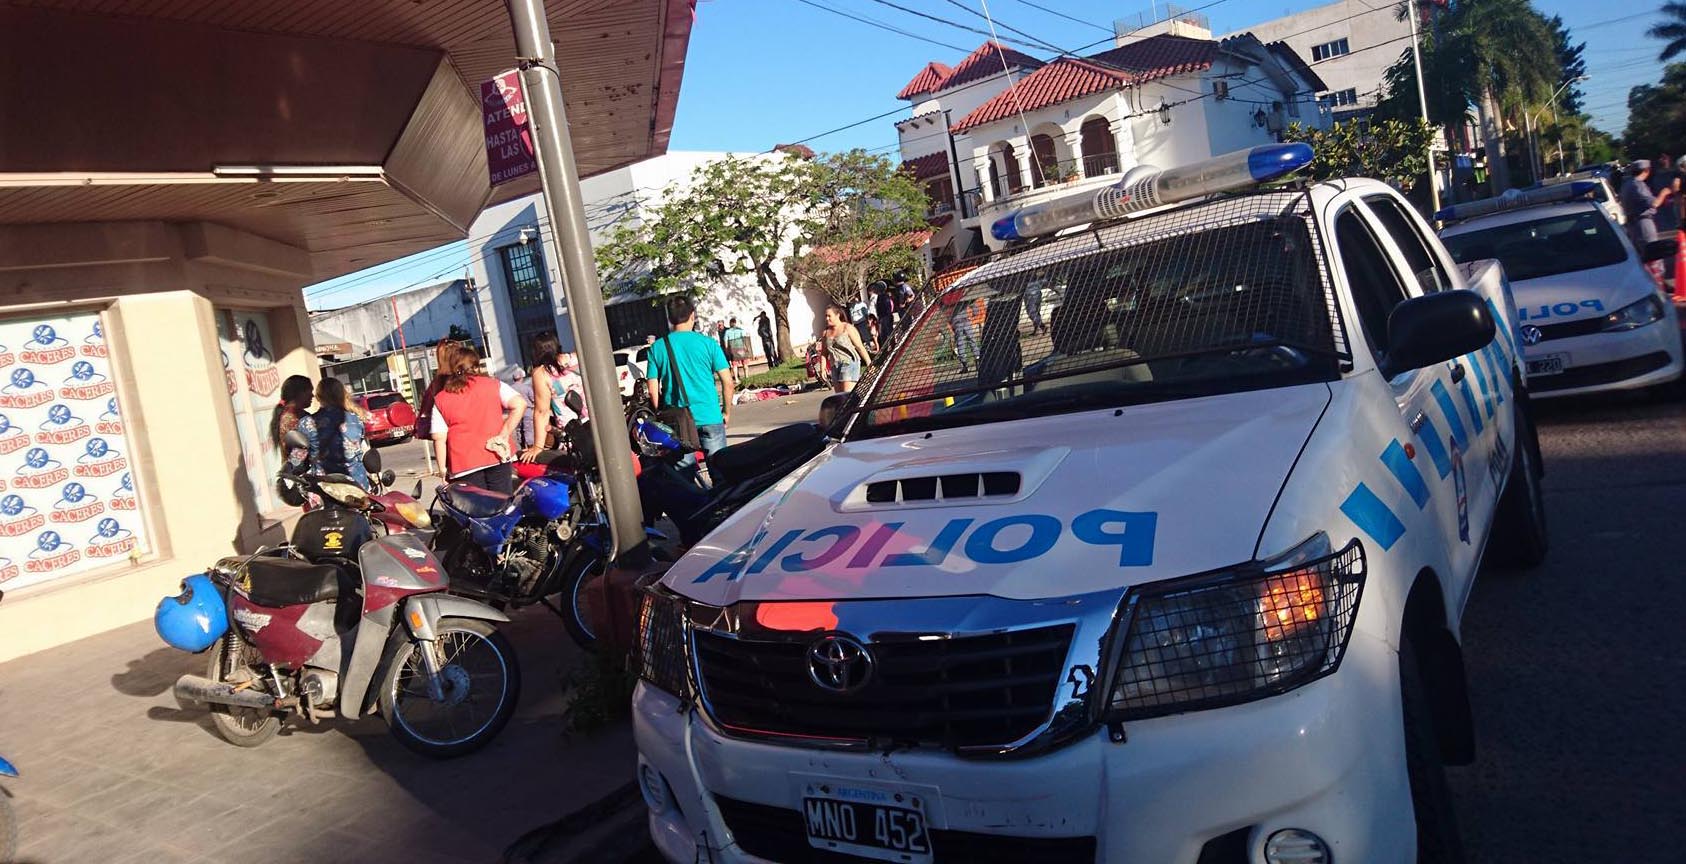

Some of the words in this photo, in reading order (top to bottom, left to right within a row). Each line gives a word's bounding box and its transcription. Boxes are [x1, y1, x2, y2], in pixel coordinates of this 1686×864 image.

[486, 128, 518, 149] HASTA
[501, 142, 519, 159] LAS
[492, 172, 502, 182] DE
[503, 163, 529, 178] LUNES
[20, 347, 75, 364] CACERES
[0, 390, 54, 409] CACERES
[59, 382, 114, 400] CACERES
[36, 425, 91, 444] CACERES
[73, 458, 127, 477] CACERES
[11, 468, 69, 488] CACERES
[50, 502, 104, 523] CACERES
[24, 550, 80, 572] CACERES
[807, 800, 857, 841] MNO
[875, 808, 926, 851] 452
